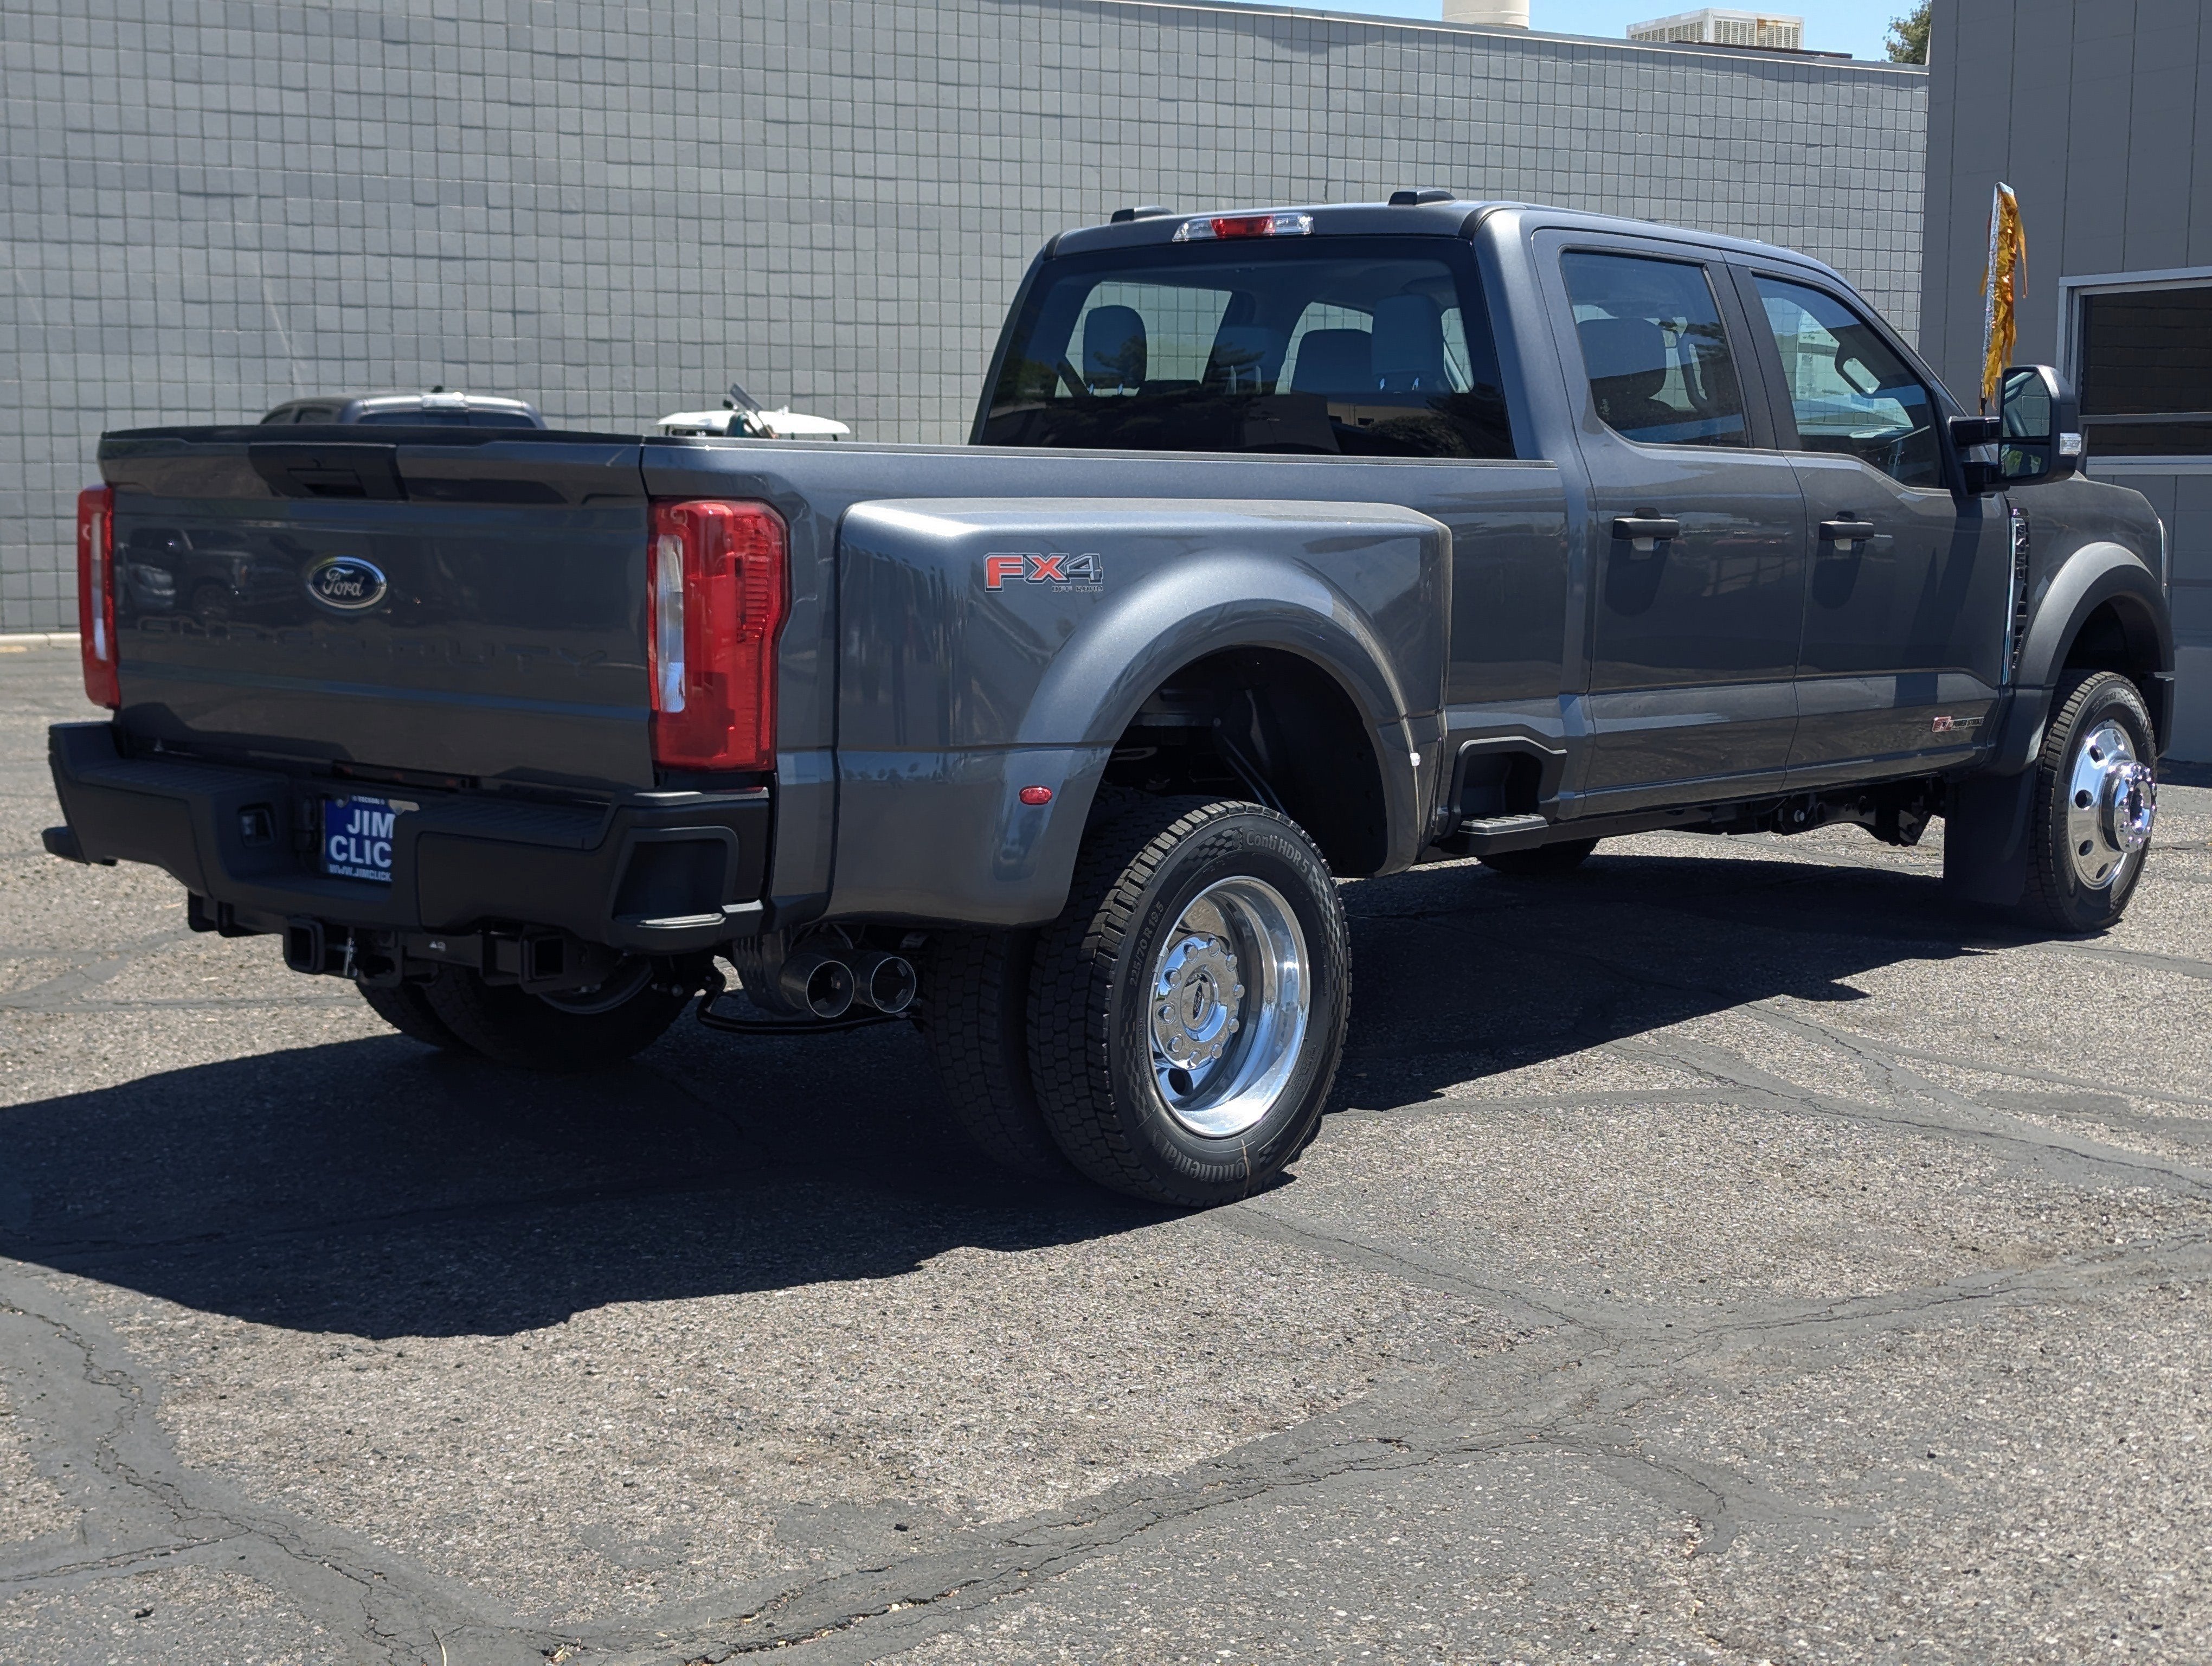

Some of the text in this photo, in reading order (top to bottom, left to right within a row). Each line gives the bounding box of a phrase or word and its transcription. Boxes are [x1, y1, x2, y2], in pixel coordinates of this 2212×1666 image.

[322, 567, 364, 597] Ford
[983, 552, 1103, 593] FX4
[346, 809, 396, 839] JIM
[1246, 828, 1310, 873] Conti HDR 5
[1148, 900, 1164, 928] 19.5
[1143, 926, 1154, 939] R
[1129, 939, 1148, 987] 225/70
[1160, 1140, 1252, 1182] Continental
